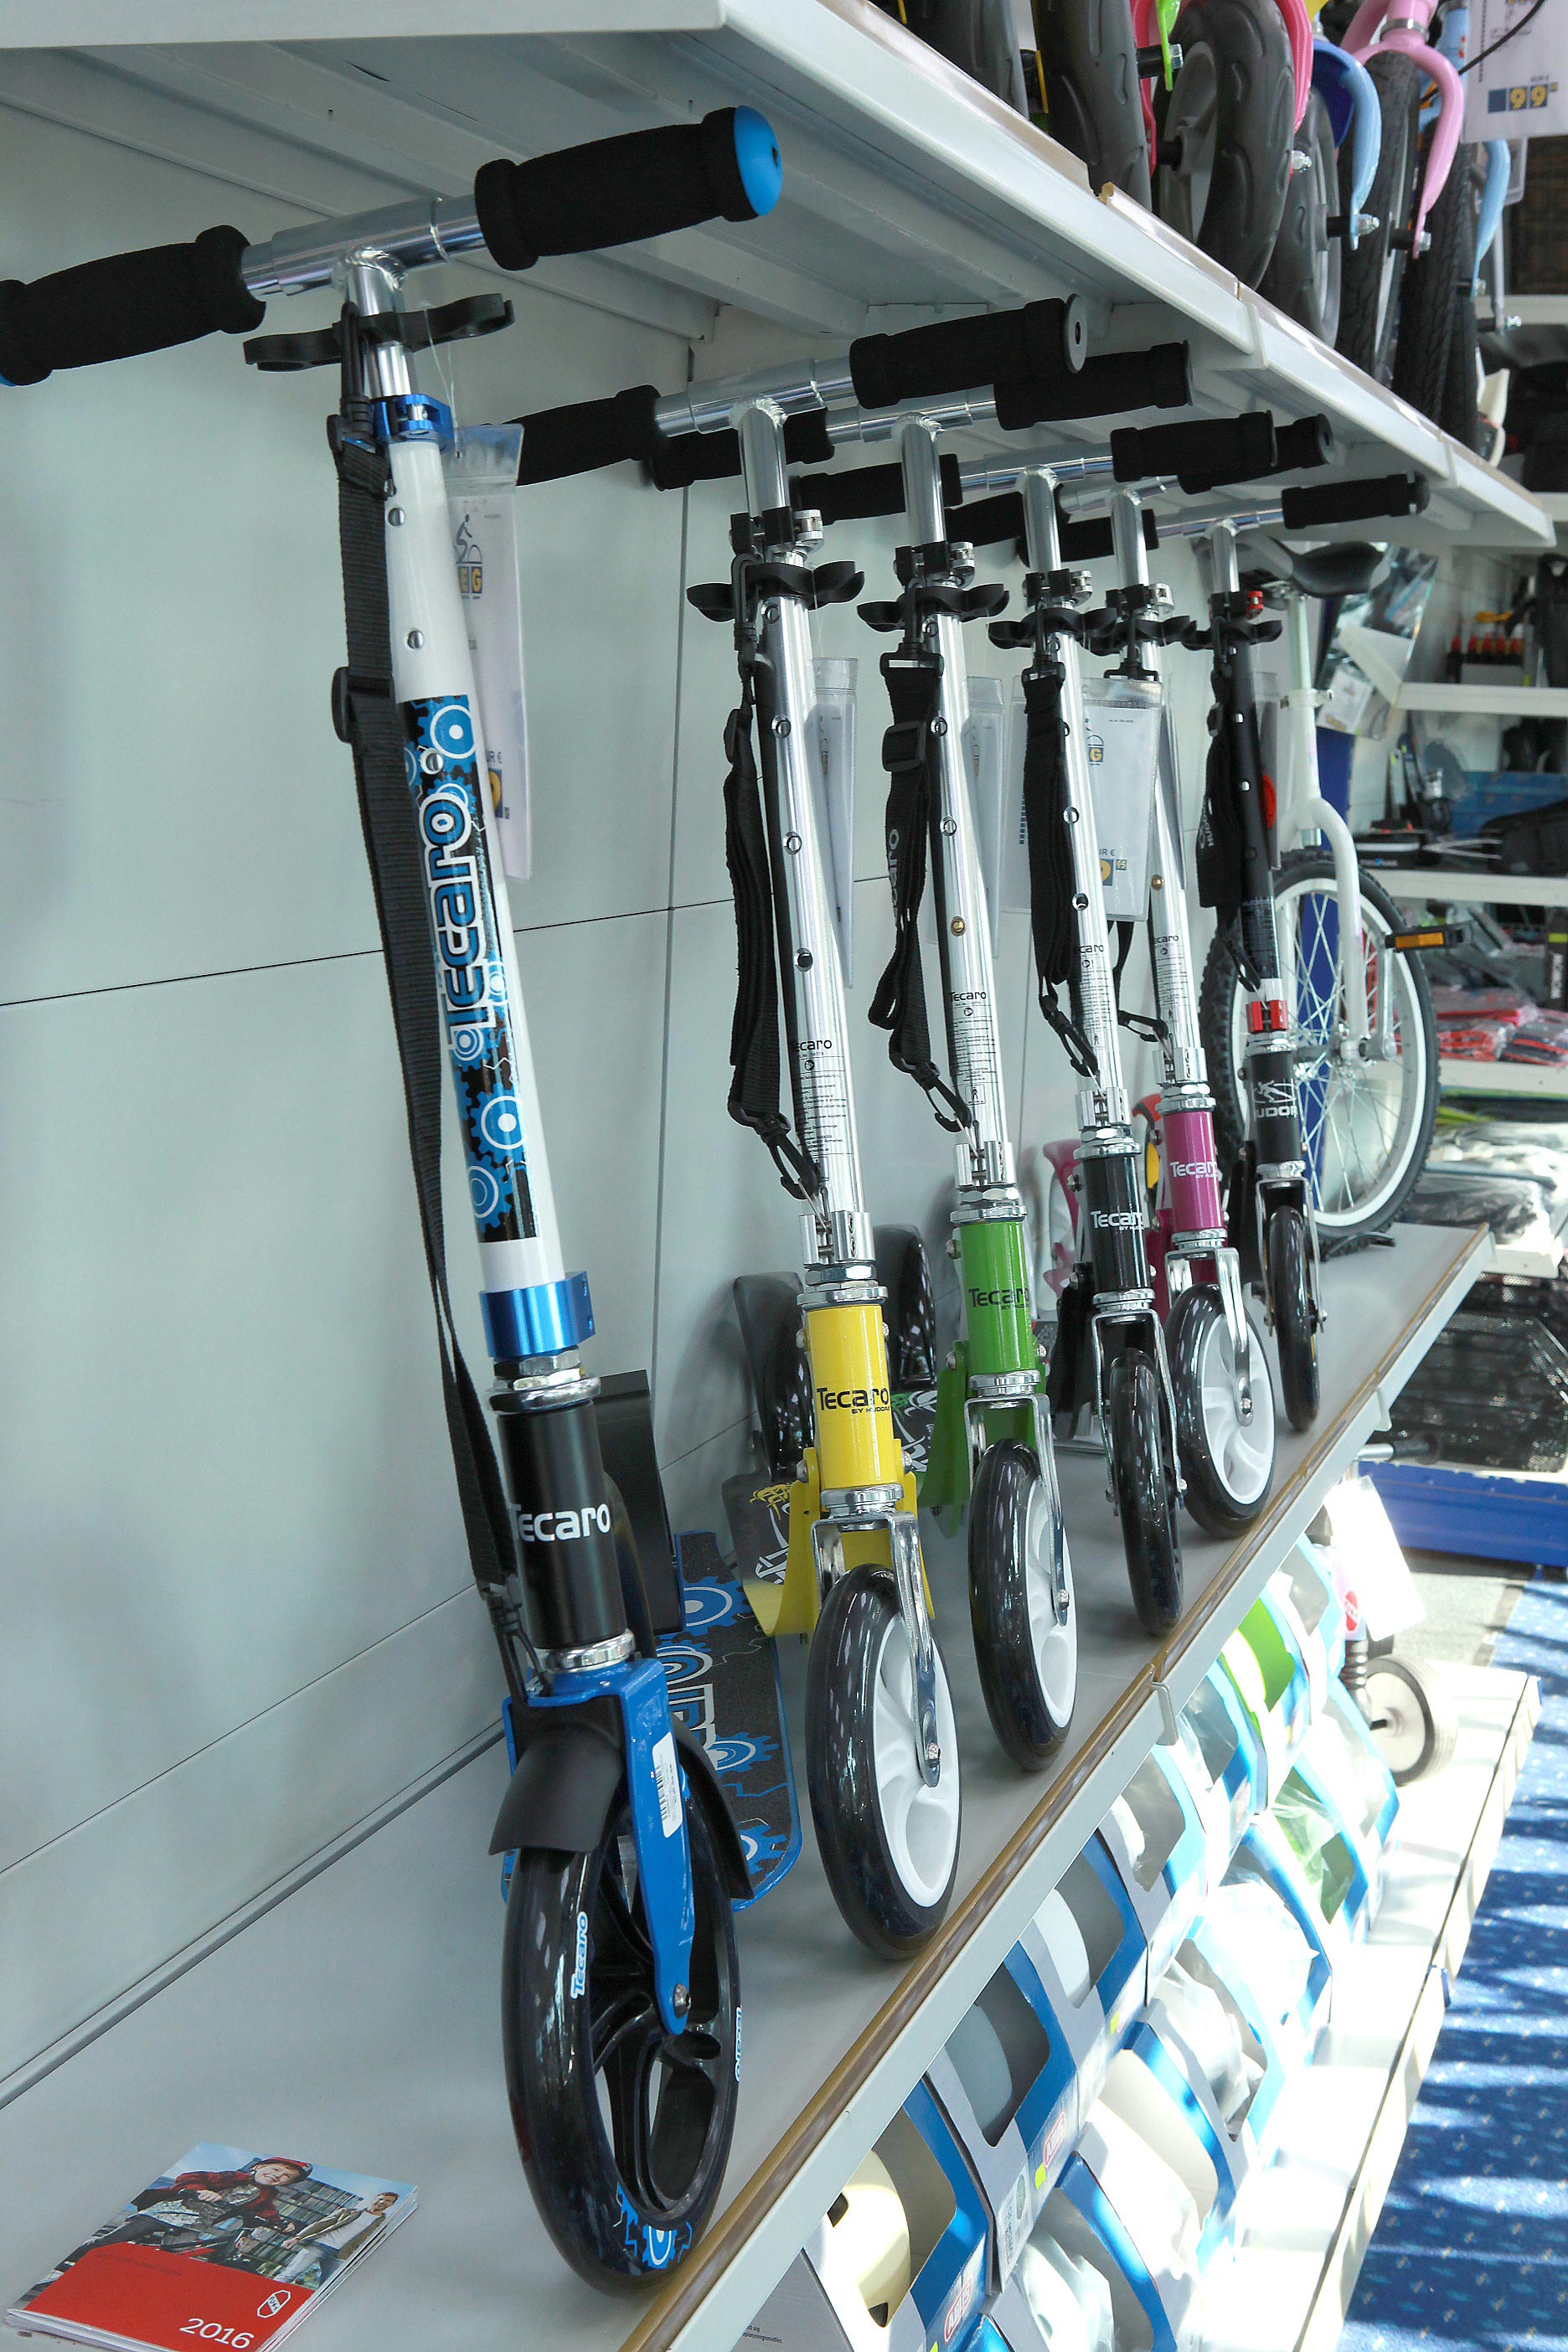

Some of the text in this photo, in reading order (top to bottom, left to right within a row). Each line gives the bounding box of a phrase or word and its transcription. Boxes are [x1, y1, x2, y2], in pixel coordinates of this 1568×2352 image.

[420, 791, 495, 1045] Tecaro
[816, 1387, 889, 1411] Tecaro
[570, 1911, 588, 1999] Tecaro
[179, 2318, 255, 2349] 2016
